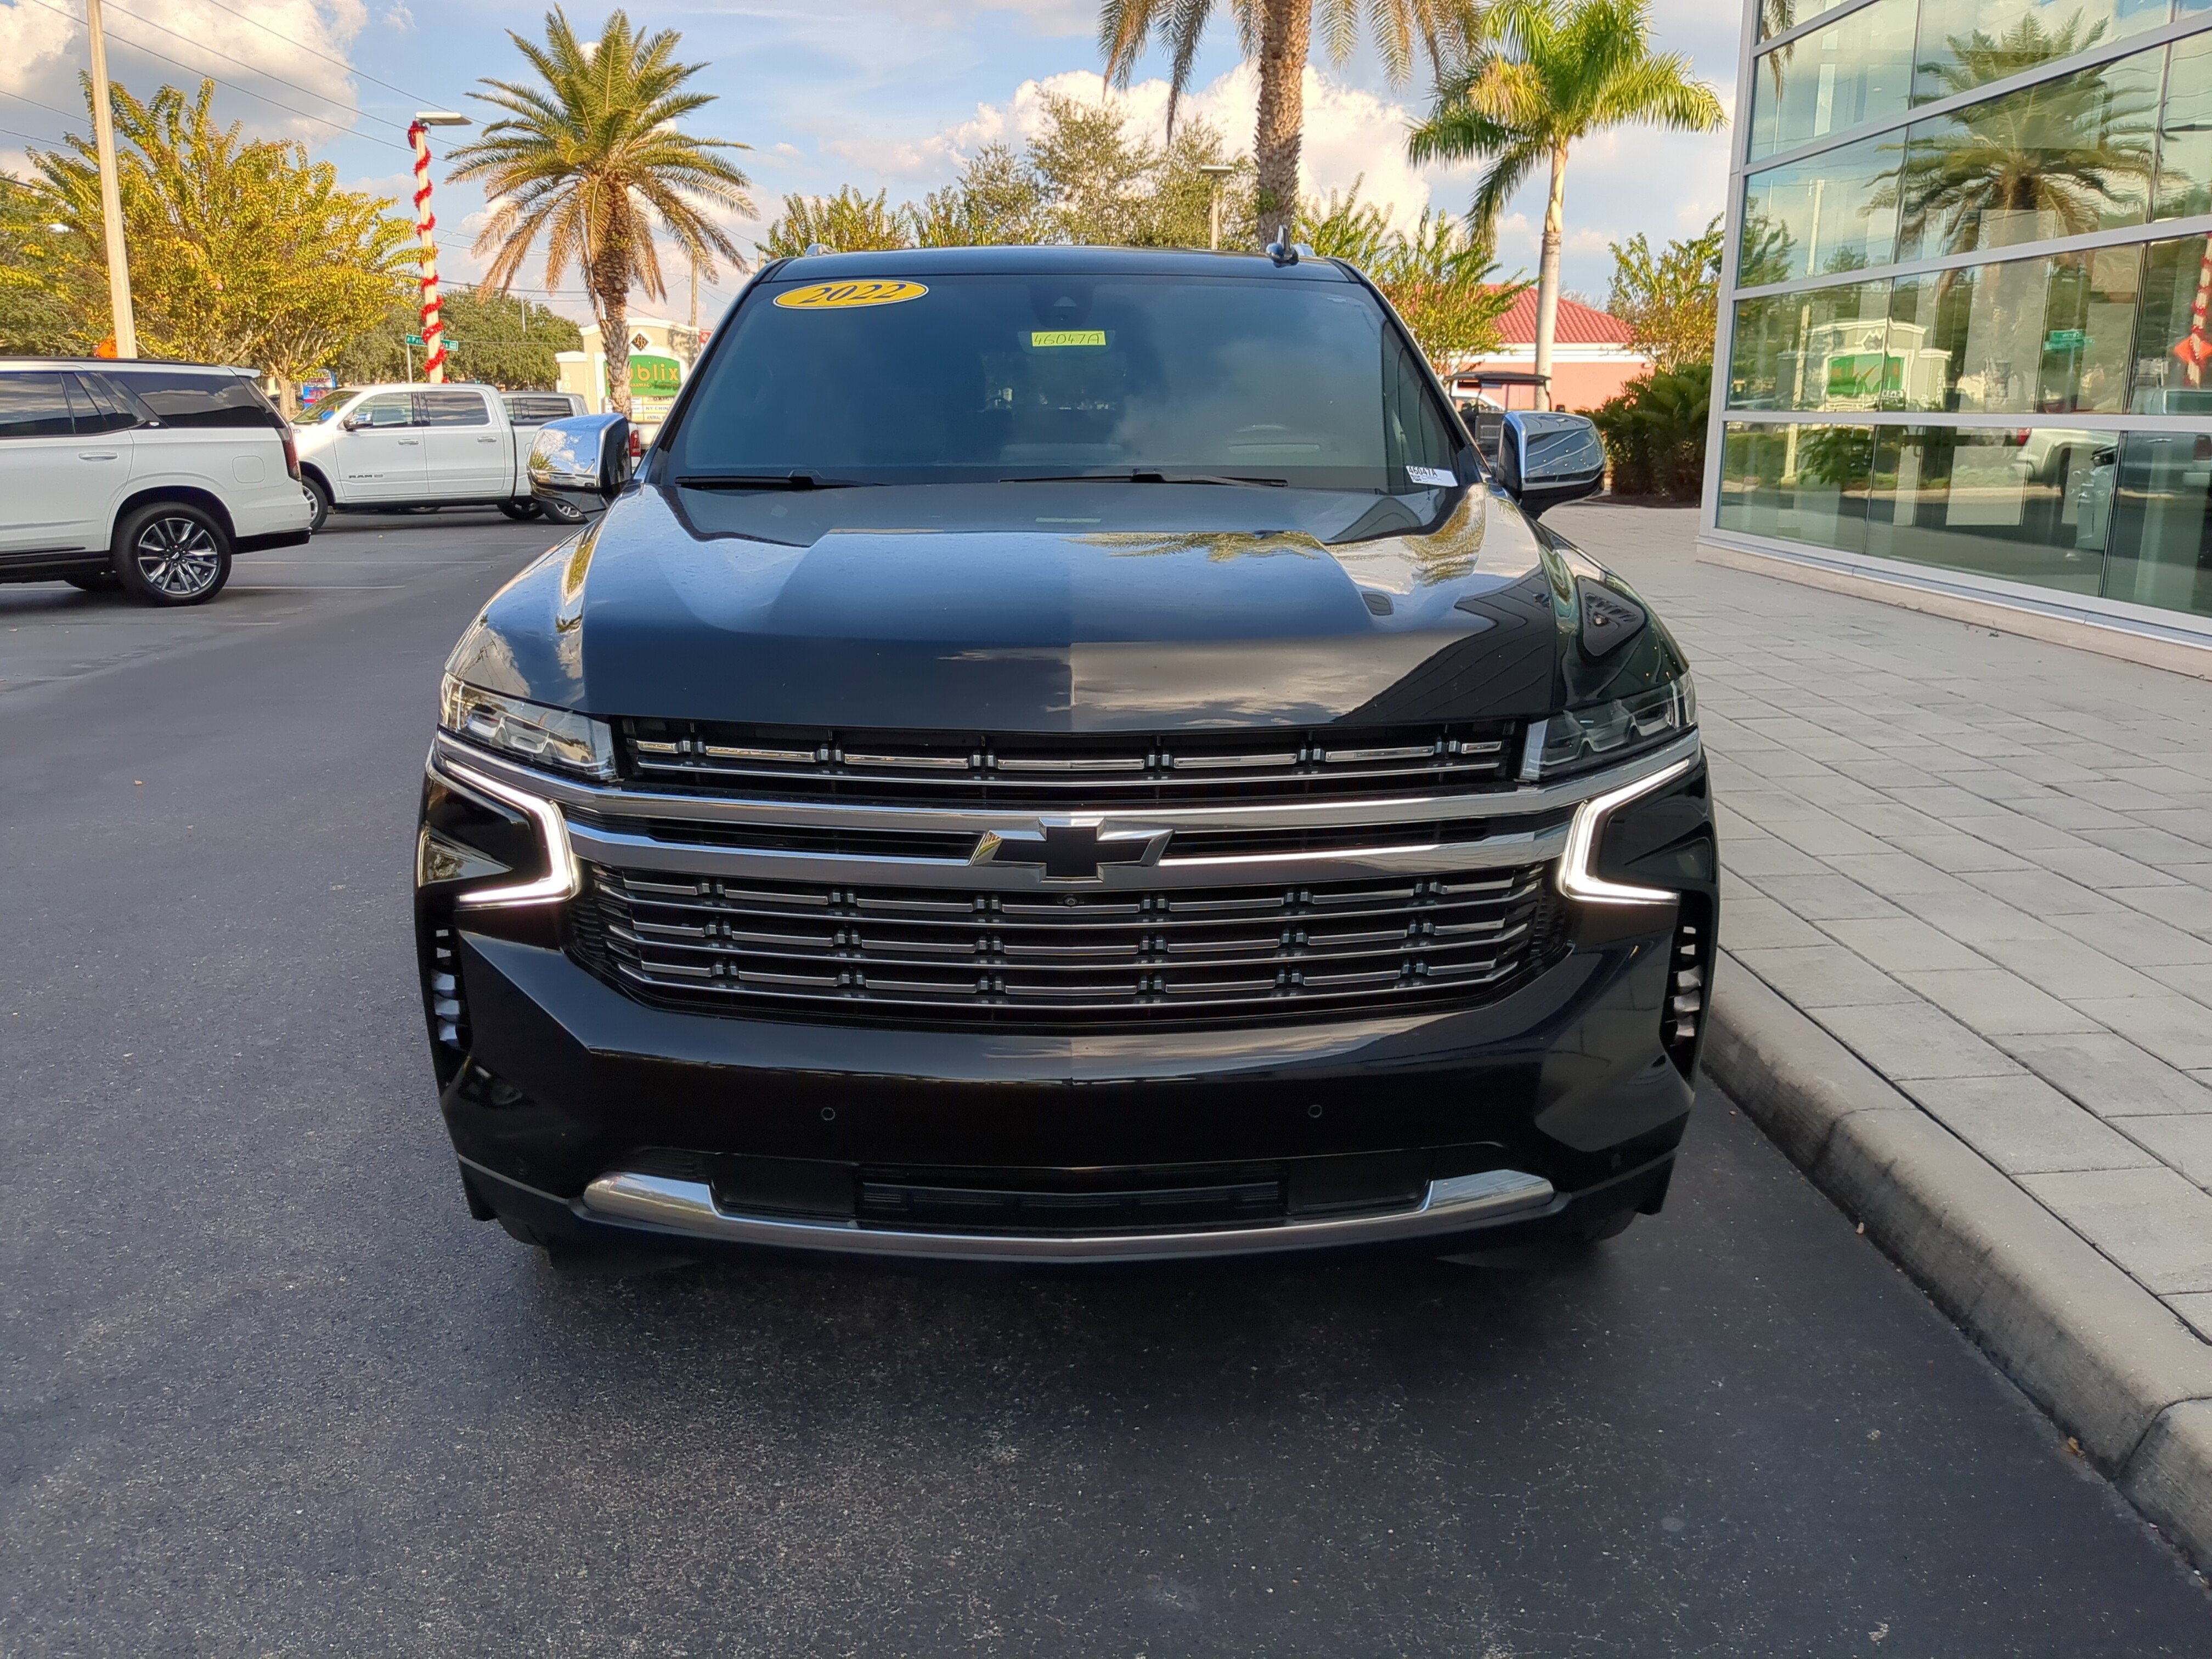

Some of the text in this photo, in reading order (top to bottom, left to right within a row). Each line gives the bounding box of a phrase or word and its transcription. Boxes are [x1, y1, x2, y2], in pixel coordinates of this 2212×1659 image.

[797, 284, 907, 304] 2022
[1034, 332, 1103, 345] 46047A
[1408, 466, 1438, 477] 46047A
